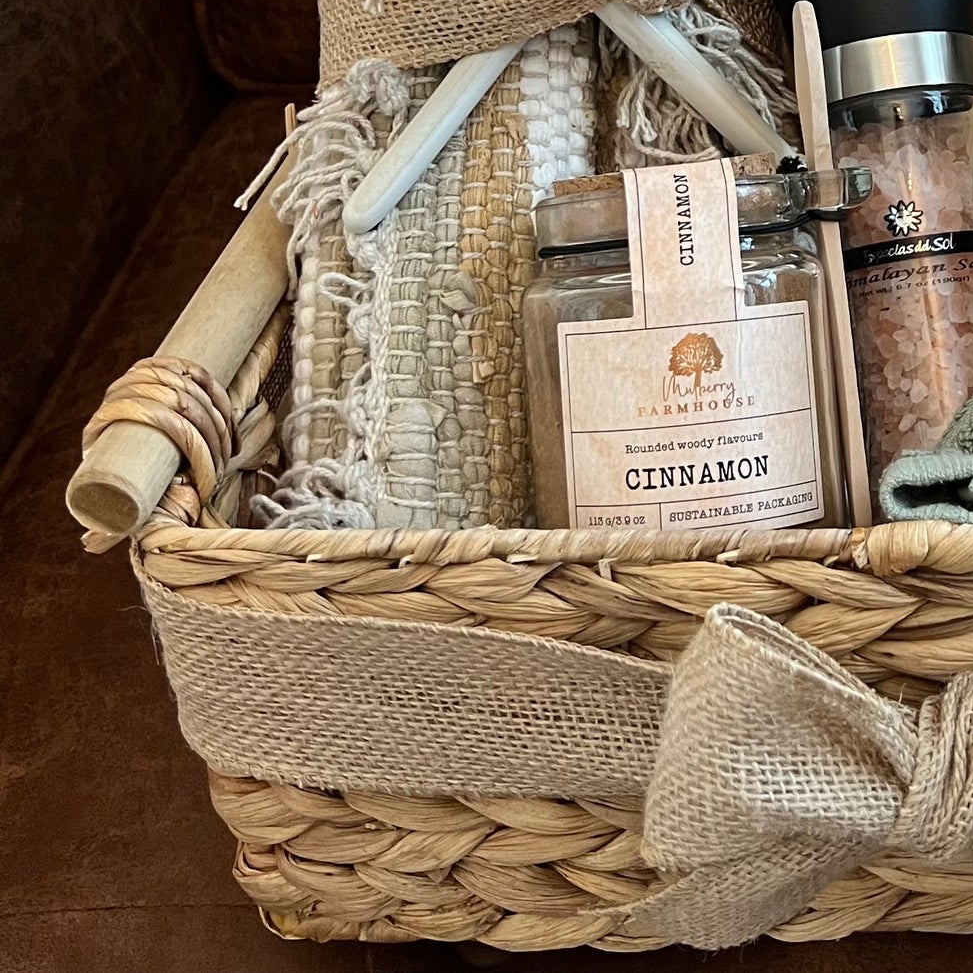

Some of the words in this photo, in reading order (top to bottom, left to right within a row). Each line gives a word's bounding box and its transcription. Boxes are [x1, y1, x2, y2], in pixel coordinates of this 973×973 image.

[673, 173, 694, 266] CINNAMON
[846, 263, 948, 289] imalayan
[662, 374, 736, 404] Mulberry
[638, 395, 755, 417] FARMHOUSE
[625, 441, 675, 454] Rounded
[677, 437, 715, 450] woody
[717, 432, 764, 446] flavours
[625, 455, 769, 490] CINNAMON
[669, 502, 754, 522] SUSTAINABLE
[757, 491, 813, 512] PACKAGING
[588, 516, 604, 526] 113
